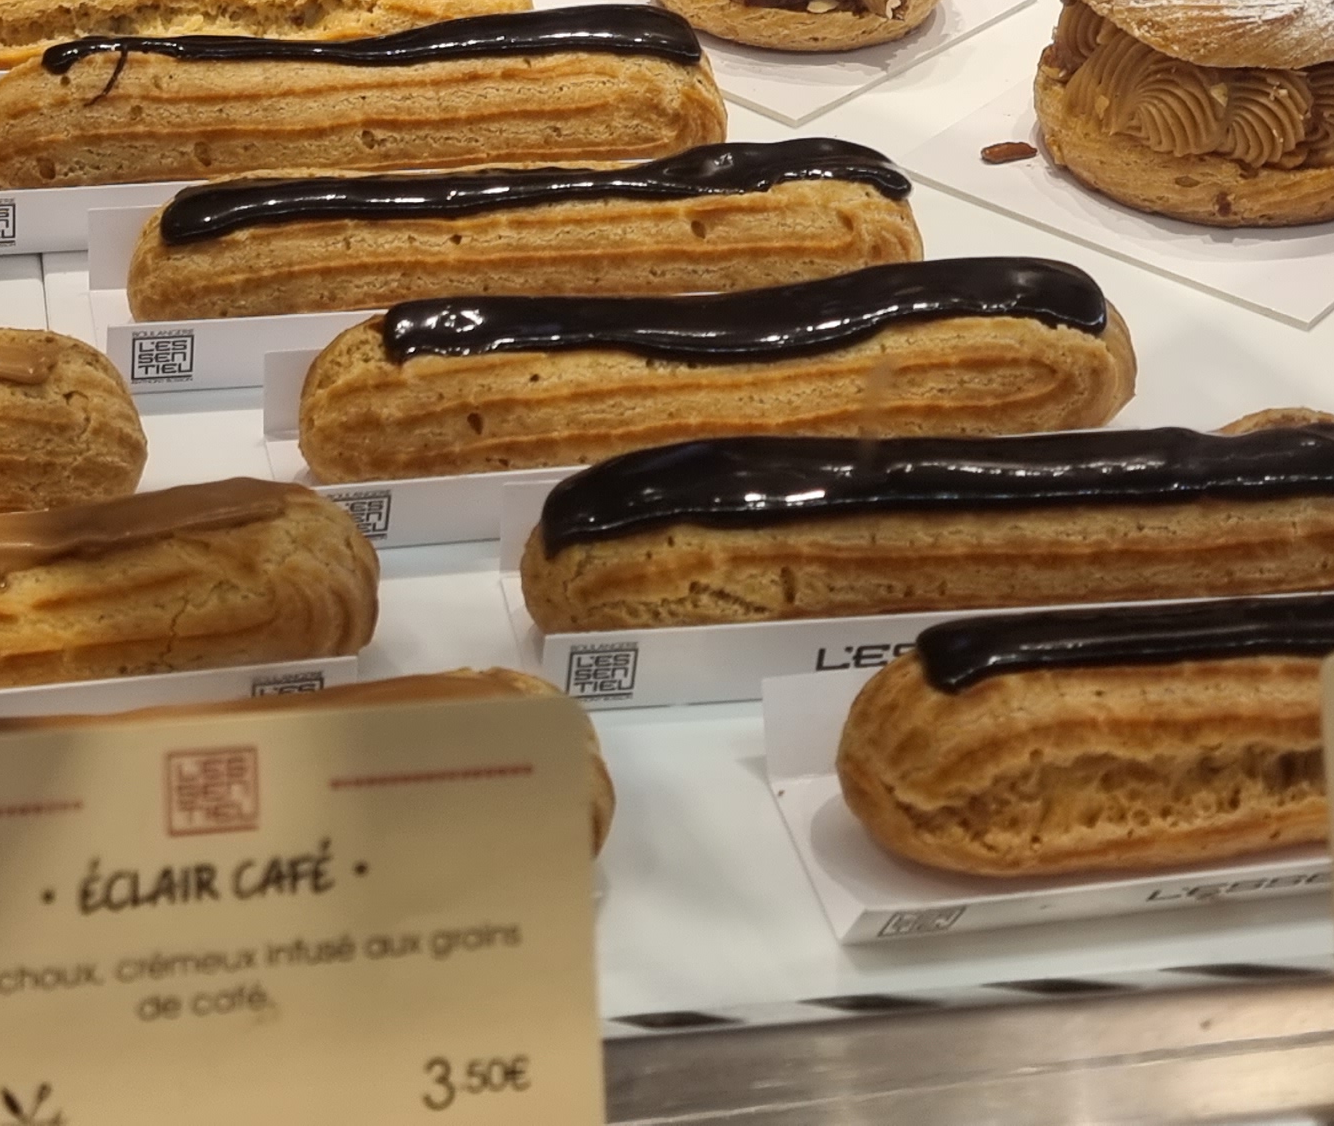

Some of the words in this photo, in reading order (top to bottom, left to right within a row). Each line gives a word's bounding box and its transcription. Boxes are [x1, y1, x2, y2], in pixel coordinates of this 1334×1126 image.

[139, 340, 187, 353] L'ES
[138, 363, 192, 375] TIEL
[78, 856, 220, 916] ÉCLAIR
[231, 837, 335, 901] CAFÉ
[116, 949, 257, 984] crémeux
[264, 932, 356, 967] infusé
[364, 932, 422, 961] aux
[428, 922, 523, 961] grains
[136, 992, 182, 1022] de
